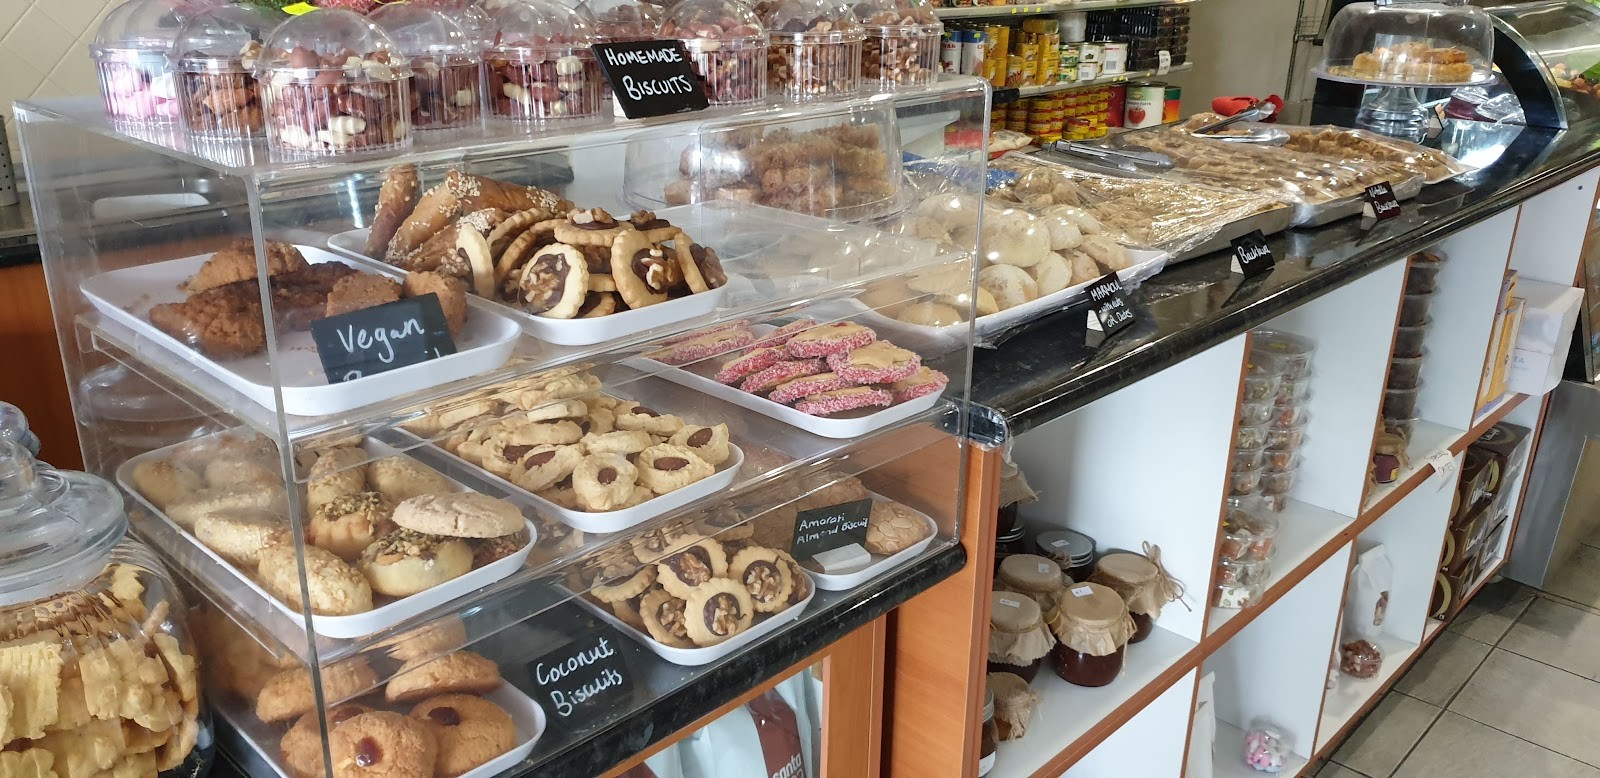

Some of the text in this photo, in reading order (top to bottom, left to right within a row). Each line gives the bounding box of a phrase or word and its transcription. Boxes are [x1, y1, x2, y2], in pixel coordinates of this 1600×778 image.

[604, 47, 682, 66] HOMEMADE
[622, 74, 693, 100] BISCUITS
[336, 318, 425, 363] Vegan
[796, 525, 838, 544] Almond
[536, 637, 614, 685] Coconut
[550, 668, 622, 717] Biscuits
